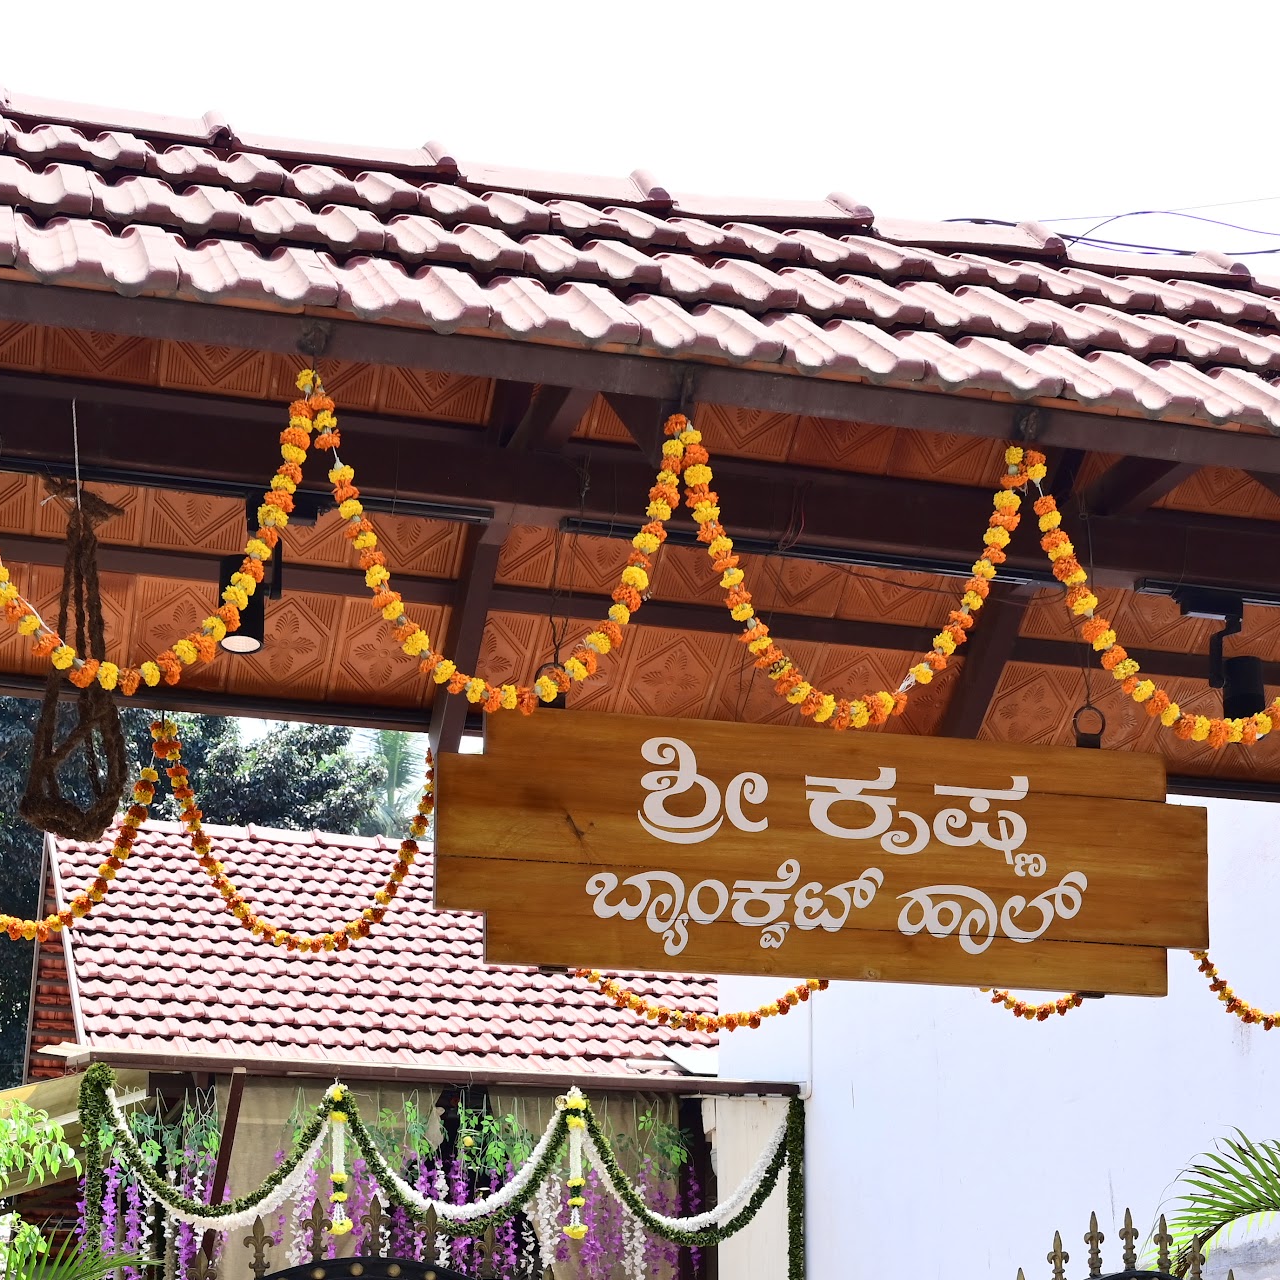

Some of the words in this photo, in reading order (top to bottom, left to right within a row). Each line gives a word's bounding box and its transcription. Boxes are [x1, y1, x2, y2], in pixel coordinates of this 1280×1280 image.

[637, 736, 769, 844] ಶ್ರೀ
[805, 766, 1047, 877] ಕೃಷ್ಣ
[896, 870, 1089, 955] ಹಾಲ್
